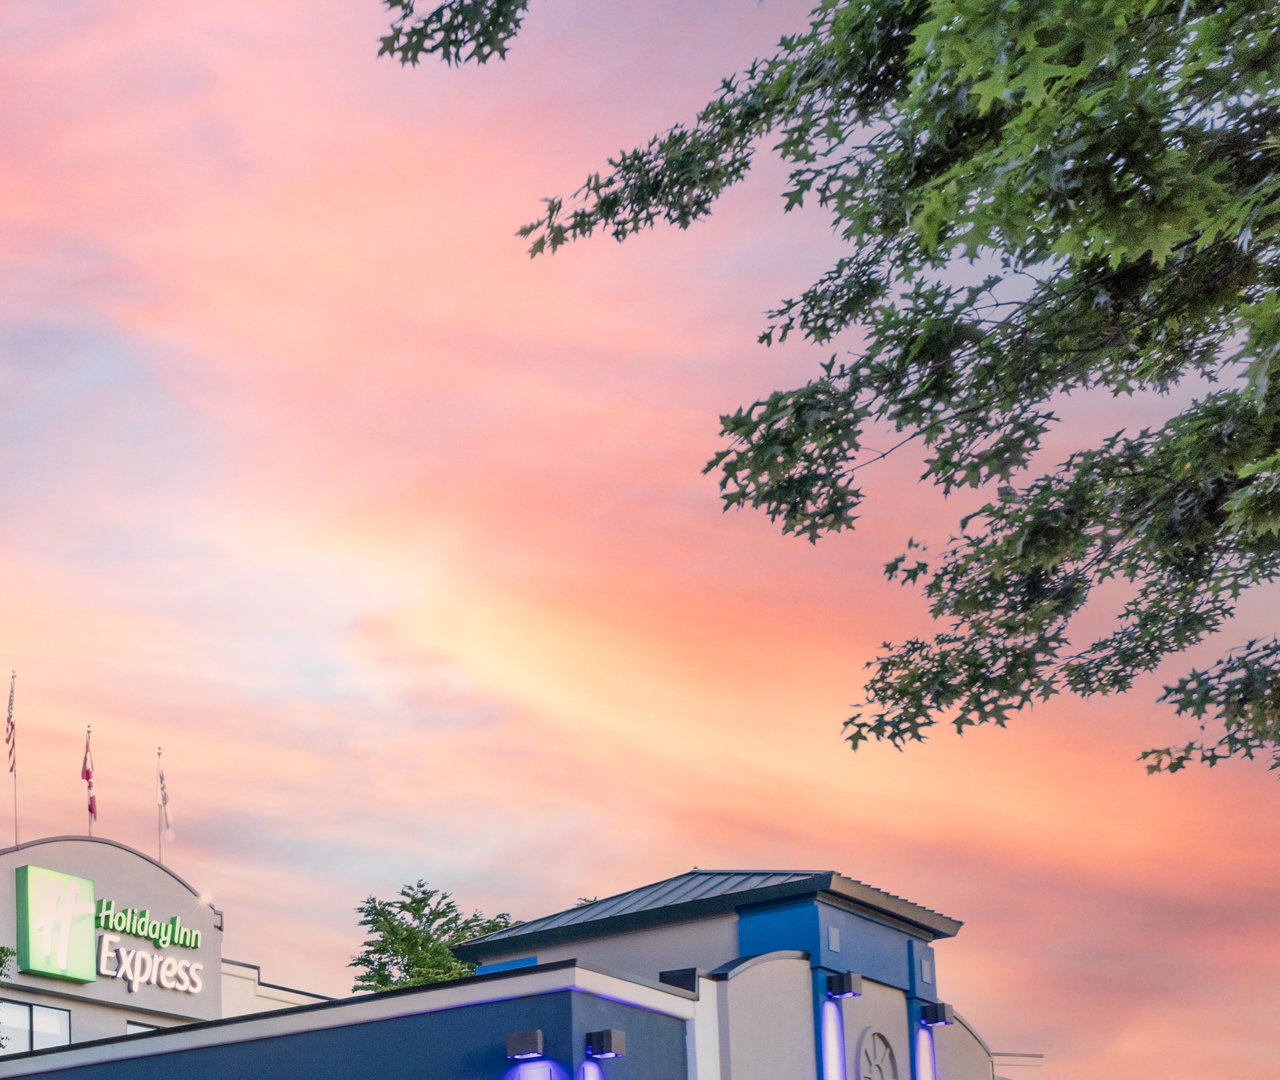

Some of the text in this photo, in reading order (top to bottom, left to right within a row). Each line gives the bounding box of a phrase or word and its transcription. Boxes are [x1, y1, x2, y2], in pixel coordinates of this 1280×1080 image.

[96, 898, 203, 949] Holiday Inn
[97, 933, 205, 994] Express
